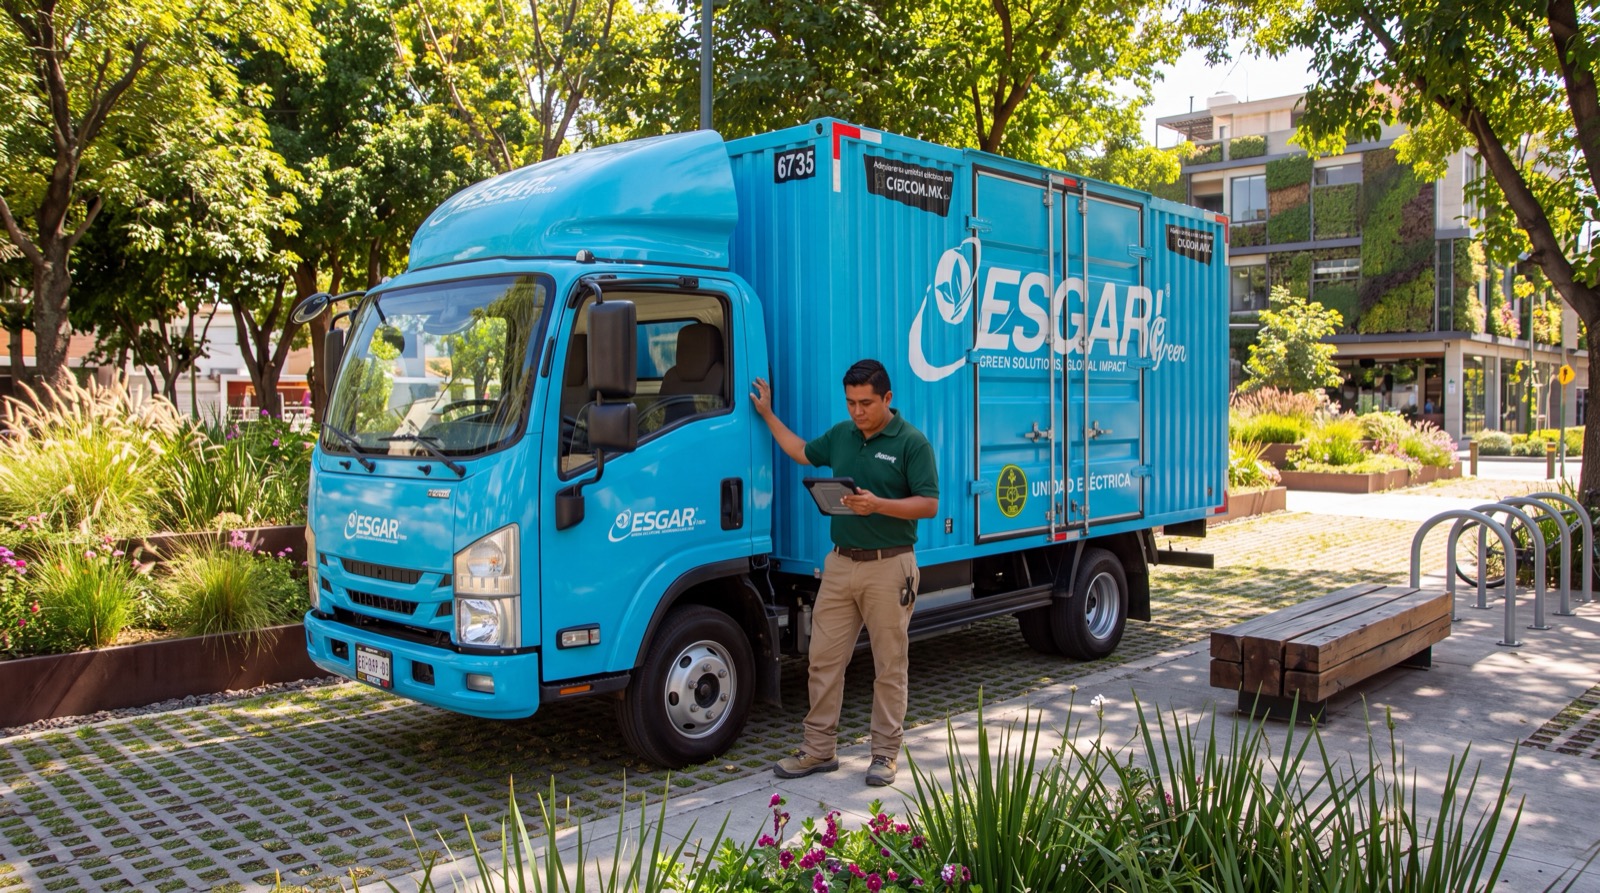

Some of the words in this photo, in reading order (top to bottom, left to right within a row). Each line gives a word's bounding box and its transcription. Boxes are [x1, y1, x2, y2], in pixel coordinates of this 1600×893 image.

[777, 150, 814, 179] 6735
[1150, 316, 1187, 371] Green
[980, 355, 1011, 369] GREEN
[1012, 356, 1064, 372] SOLUTIOS,
[1067, 359, 1098, 372] GLOAL
[1100, 360, 1127, 372] IMPACT
[1077, 472, 1132, 493] EÉCTRICA
[356, 515, 399, 540] ESGAR
[632, 507, 695, 532] ESGAR
